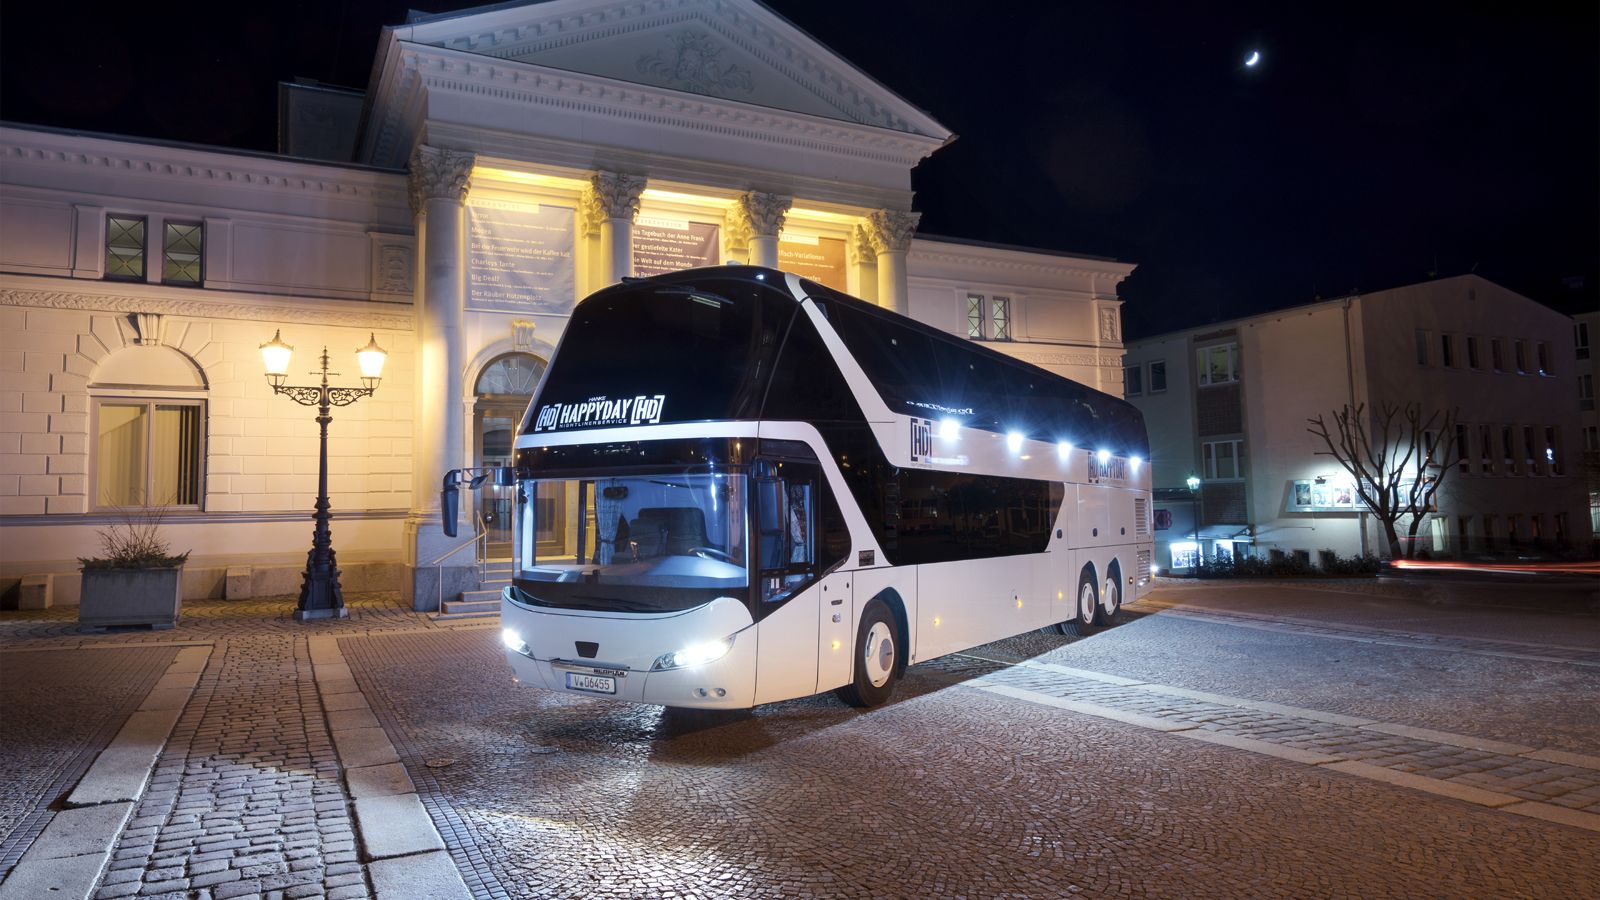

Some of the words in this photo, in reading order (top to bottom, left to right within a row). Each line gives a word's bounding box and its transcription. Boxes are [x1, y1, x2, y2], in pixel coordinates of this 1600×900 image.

[641, 230, 666, 238] Tagebuch
[560, 398, 634, 424] HAPPYDAY
[584, 677, 610, 690] 06455
